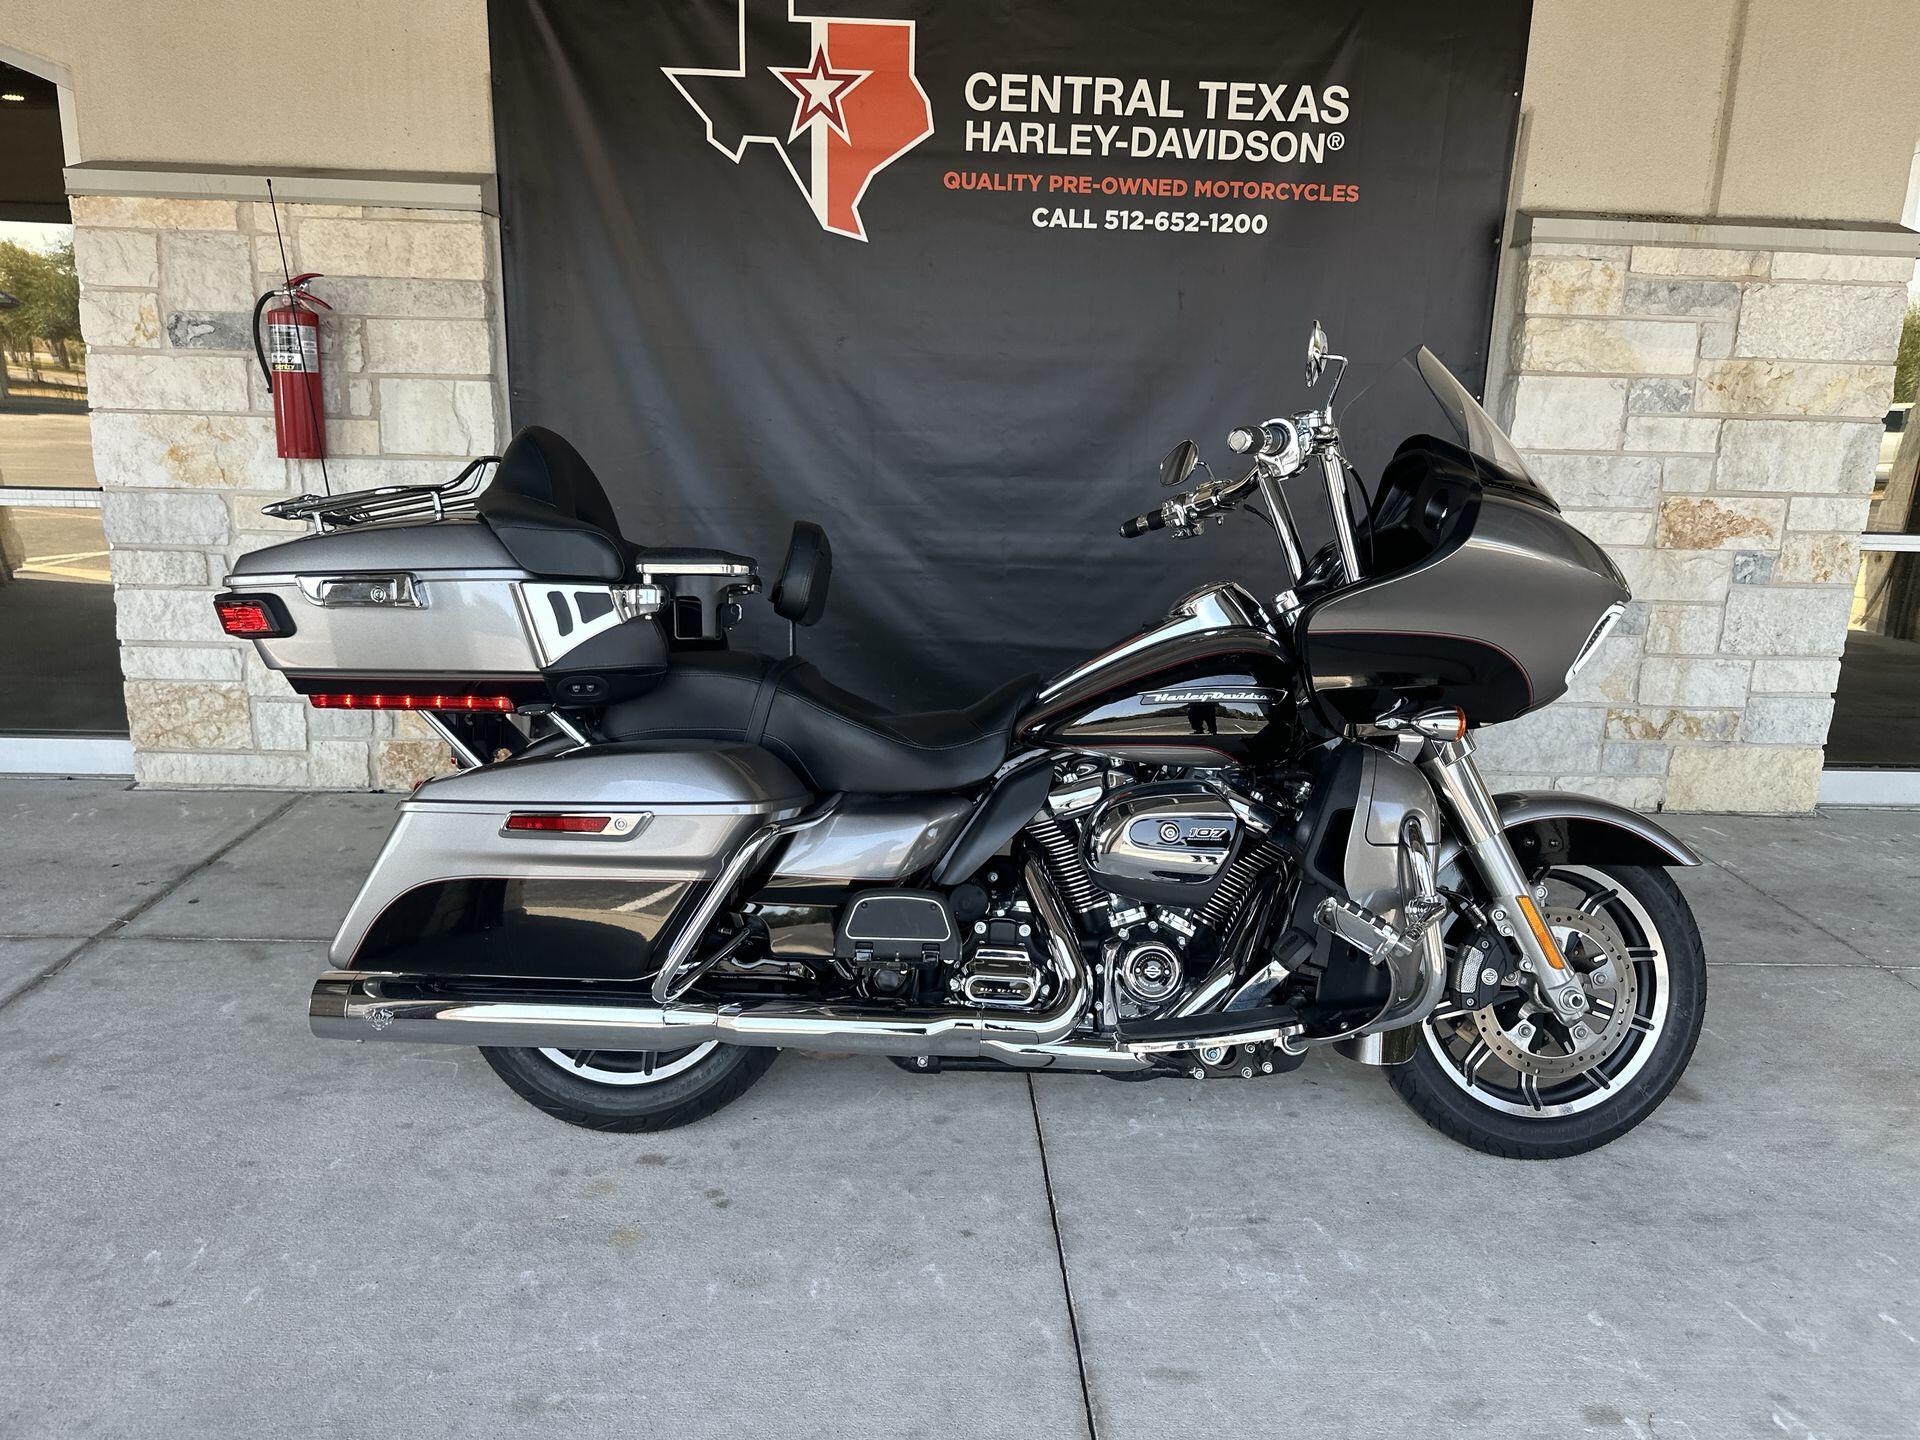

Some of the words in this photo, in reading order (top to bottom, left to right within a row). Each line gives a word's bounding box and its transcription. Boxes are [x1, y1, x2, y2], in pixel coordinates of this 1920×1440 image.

[964, 72, 1184, 118] CENTRAL
[1198, 81, 1350, 124] TEXAS
[943, 171, 1043, 193] QUALITY
[1048, 174, 1187, 198] PRE-OWNED
[1193, 180, 1360, 203] MOTORCYCLES
[1032, 207, 1098, 229] CALL
[1103, 209, 1268, 234] 512-652-1200
[1189, 827, 1227, 838] 107
